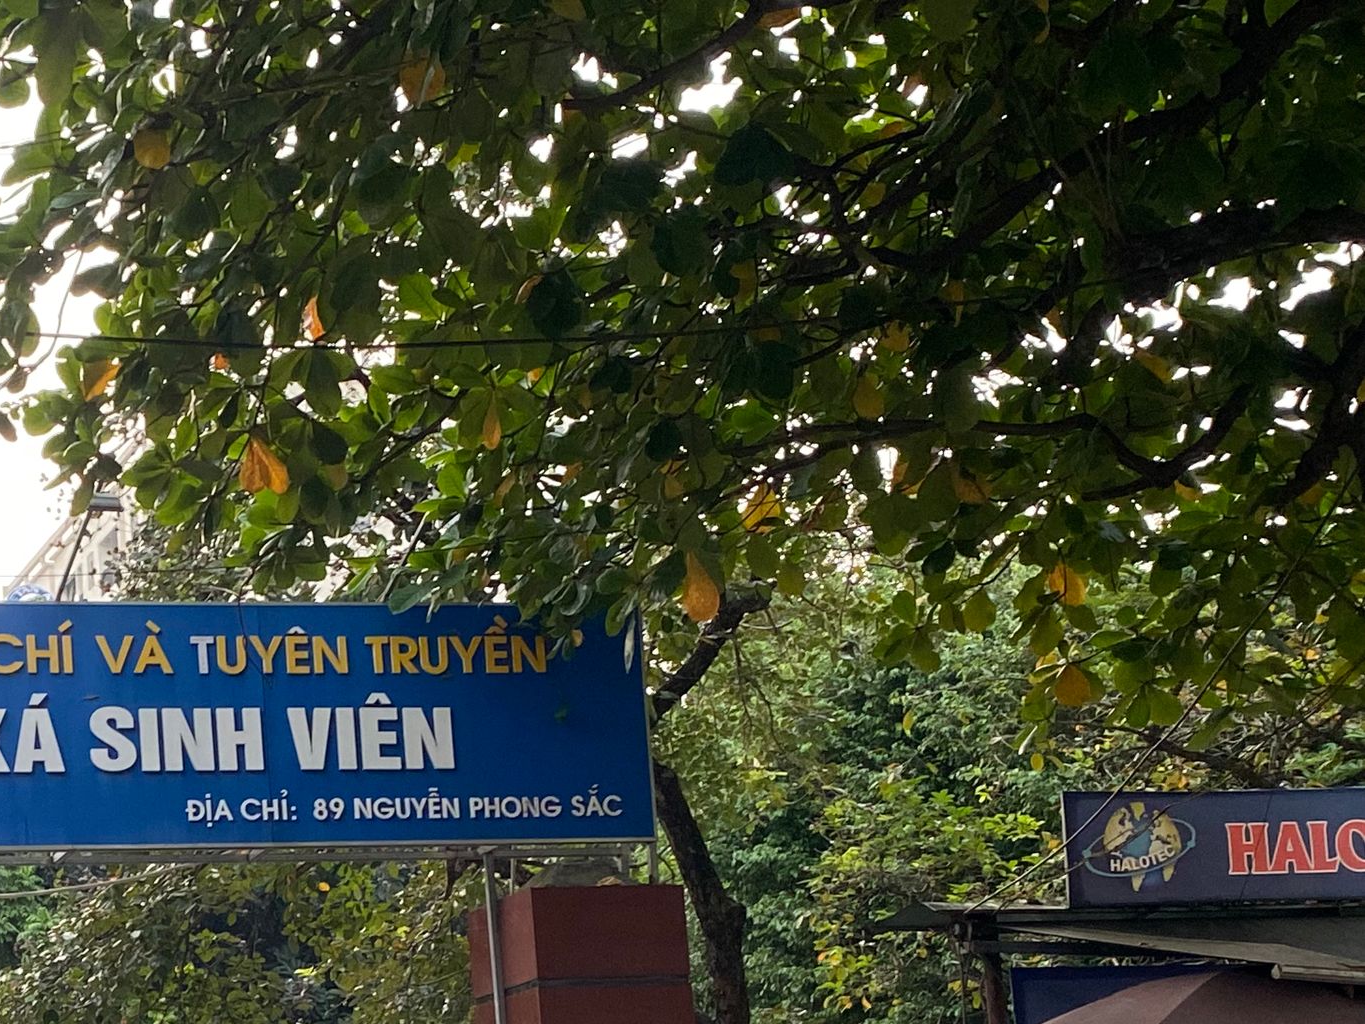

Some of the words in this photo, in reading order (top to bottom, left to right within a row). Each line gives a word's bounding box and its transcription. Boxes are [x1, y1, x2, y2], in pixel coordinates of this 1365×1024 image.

[95, 619, 175, 675] VÀ
[189, 626, 349, 675] TUYÊN
[363, 615, 548, 674] TRUYỀN
[89, 706, 266, 772] SINH
[286, 692, 457, 771] VIÊN
[185, 793, 234, 828] ĐỊA
[239, 788, 298, 822] CHỈ:
[313, 796, 345, 821] 89
[353, 787, 461, 820] NGUYỄN
[468, 795, 562, 819] PHONG
[570, 783, 624, 817] SẮC
[1109, 847, 1176, 872] HALOTEC
